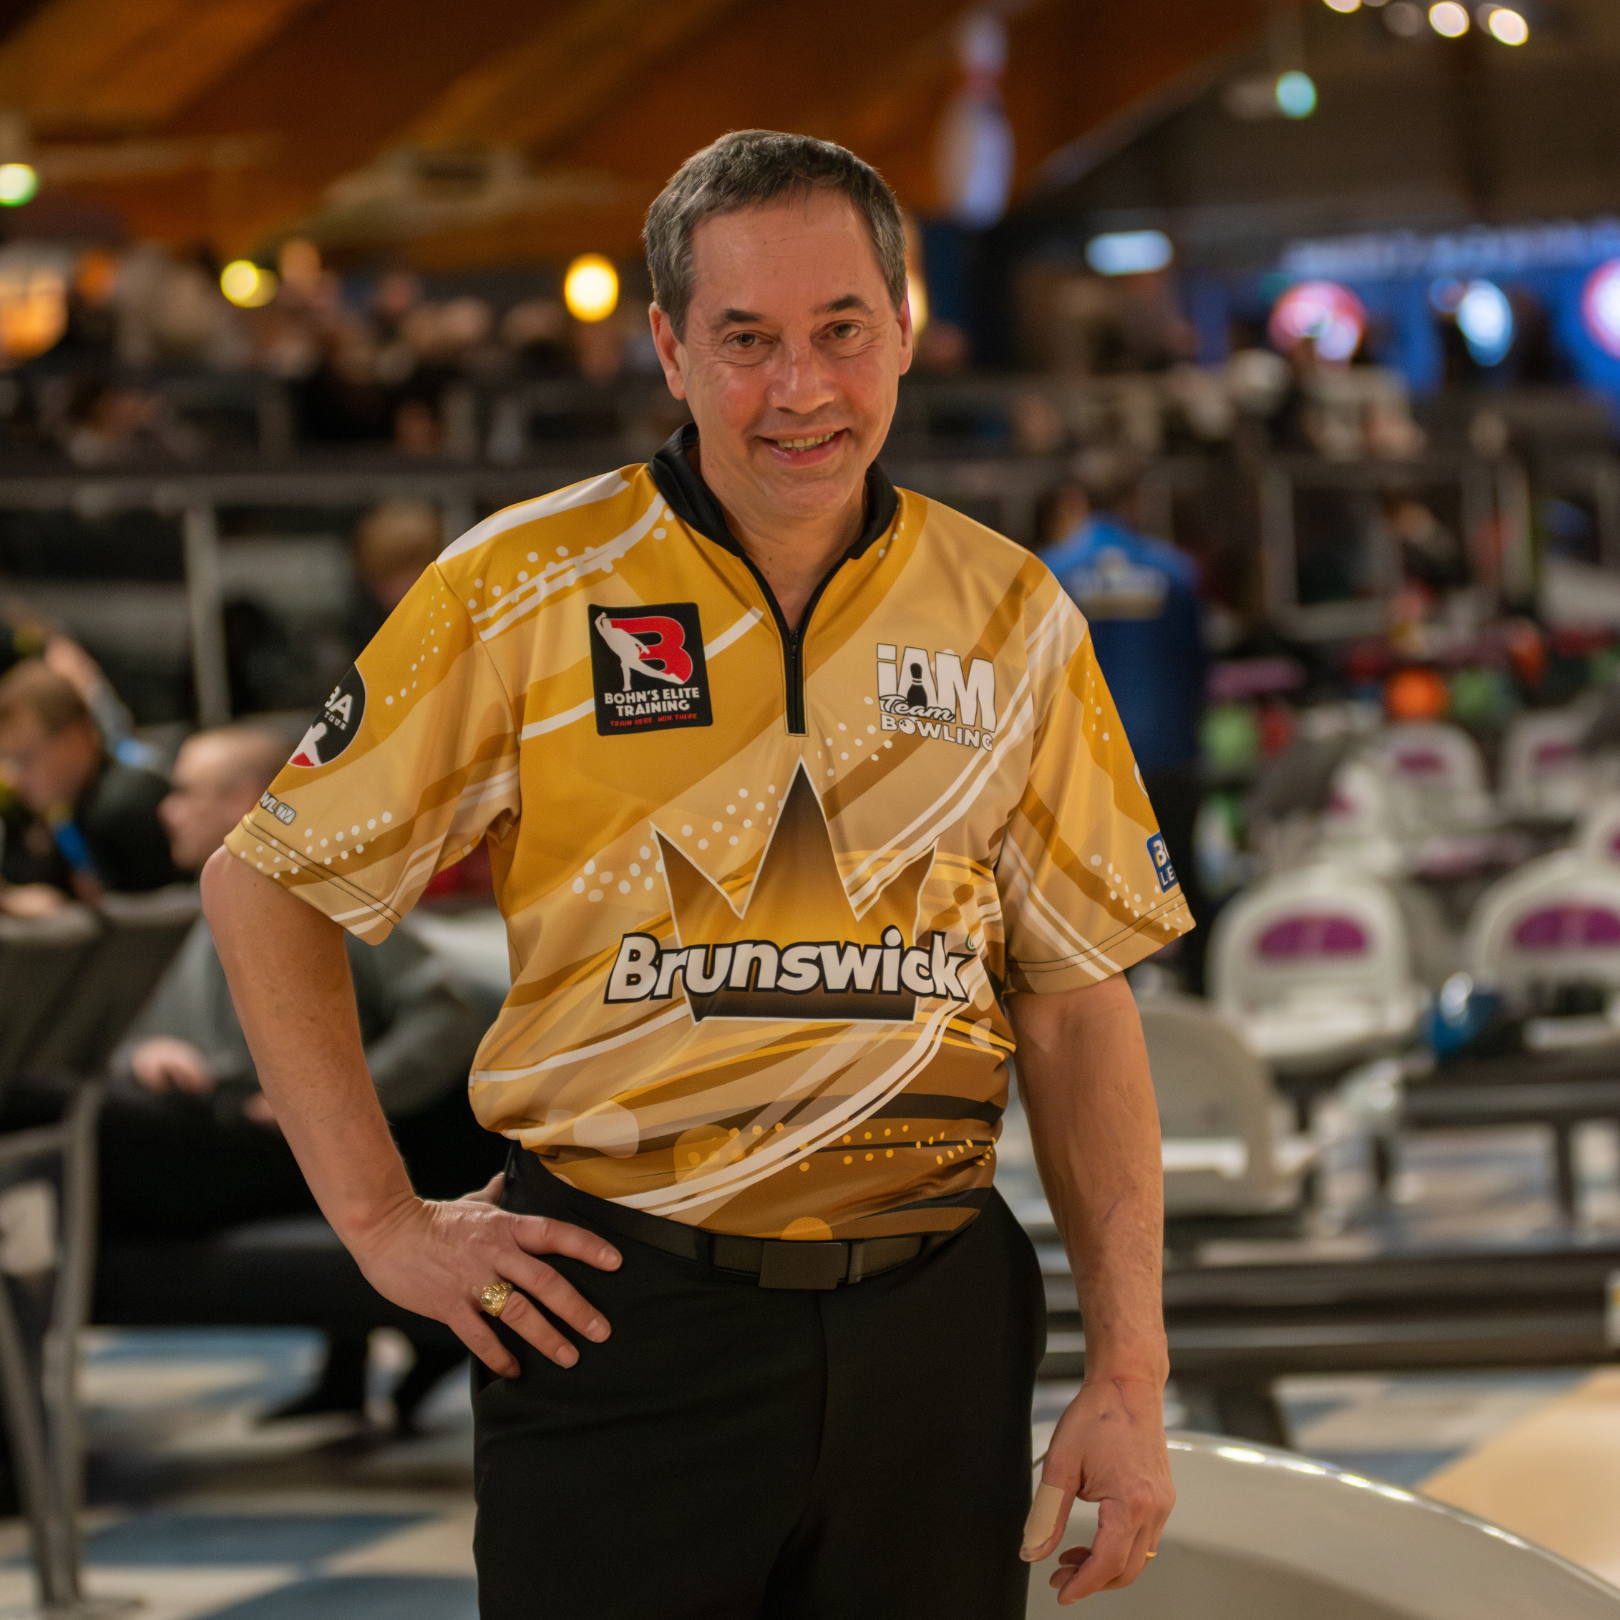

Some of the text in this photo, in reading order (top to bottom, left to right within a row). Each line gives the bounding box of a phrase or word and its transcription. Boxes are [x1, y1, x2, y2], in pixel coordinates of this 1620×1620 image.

[604, 687, 700, 705] BOHN'S ELITE
[878, 694, 956, 721] Team
[616, 699, 690, 717] TRAINING
[324, 711, 347, 731] TOUR
[880, 713, 993, 752] BOWLING
[603, 924, 977, 1004] Brunswick
